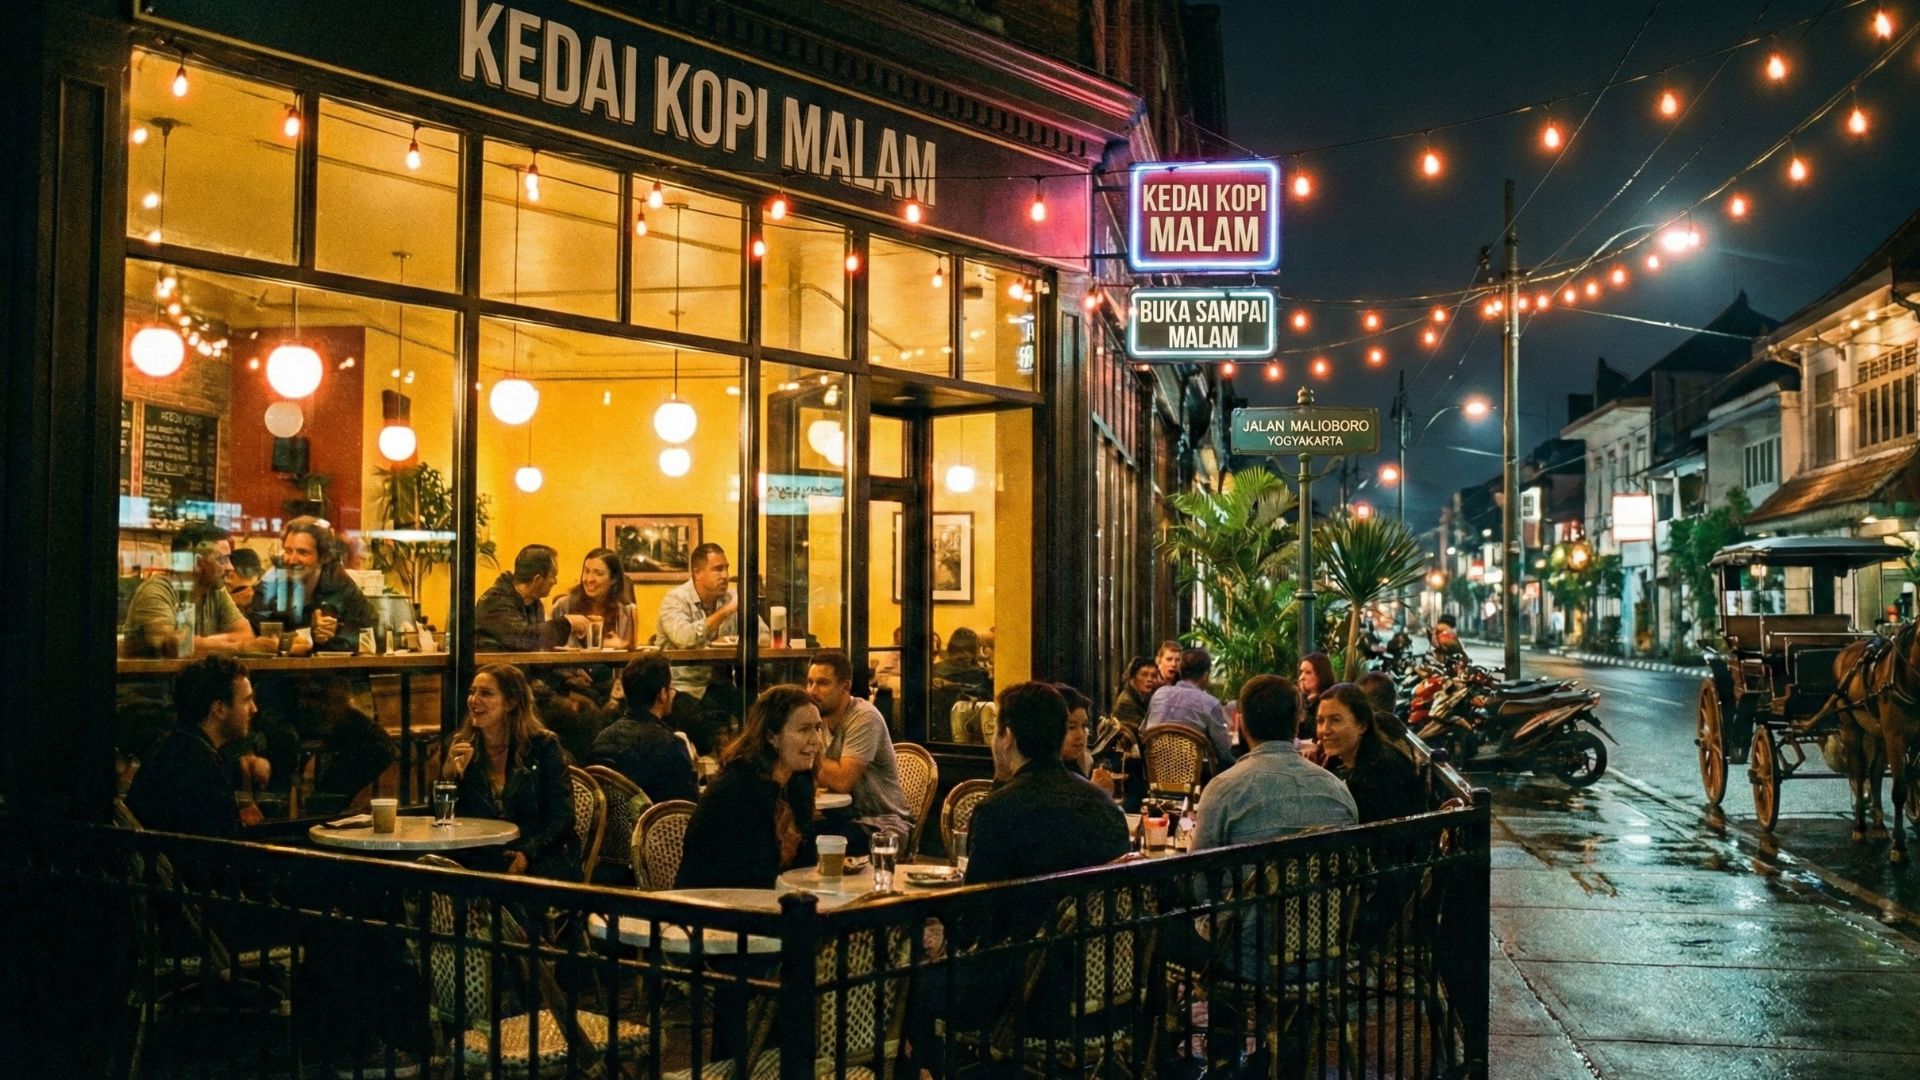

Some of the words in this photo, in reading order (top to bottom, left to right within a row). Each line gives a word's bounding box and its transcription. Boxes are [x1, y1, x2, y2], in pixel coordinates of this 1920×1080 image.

[460, 0, 637, 125] KEDAI
[654, 55, 768, 160] KOPI
[782, 96, 936, 206] MALAM
[1143, 184, 1208, 212] KEDAI
[1216, 184, 1266, 212] KOPI
[1150, 216, 1259, 252] MALAM
[1140, 300, 1191, 323] BUKA
[1196, 300, 1266, 323] SAMPAI
[1169, 325, 1238, 348] MALAM
[1243, 420, 1284, 432] JALAN
[1290, 420, 1369, 432] MALIOBORO
[1267, 435, 1344, 446] YOGYAKARTA
